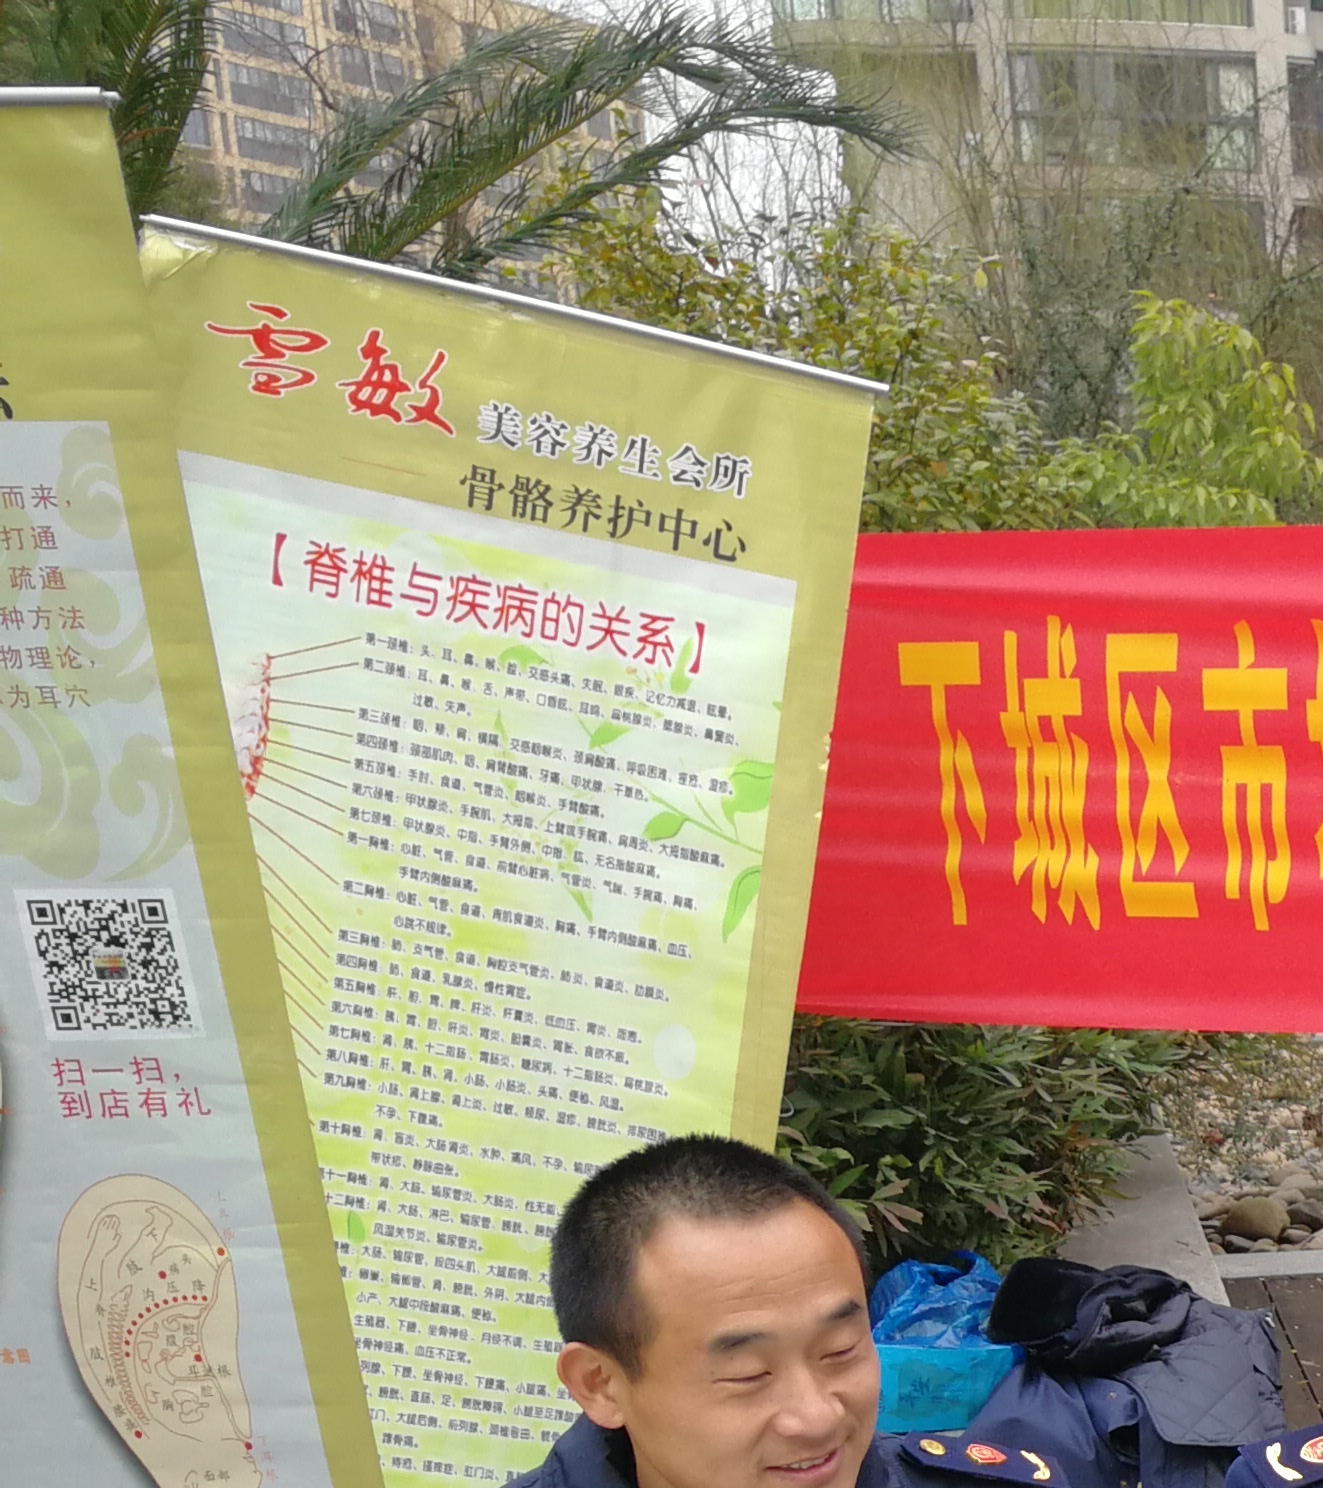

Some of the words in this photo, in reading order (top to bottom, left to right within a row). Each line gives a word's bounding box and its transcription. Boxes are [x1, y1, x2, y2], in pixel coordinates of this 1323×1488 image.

[476, 402, 753, 499] 美容养生会所
[1, 484, 72, 509] 而来，
[458, 465, 748, 562] 骨骼养护中心
[1, 525, 59, 551] 打通
[9, 566, 68, 592] 疏通
[272, 532, 706, 674] 【脊椎与疾病的关系】
[0, 605, 86, 631] 种方法
[6, 684, 93, 710] 为耳穴
[51, 1056, 181, 1087] 扫一扫，
[58, 1087, 212, 1120] 到店有礼
